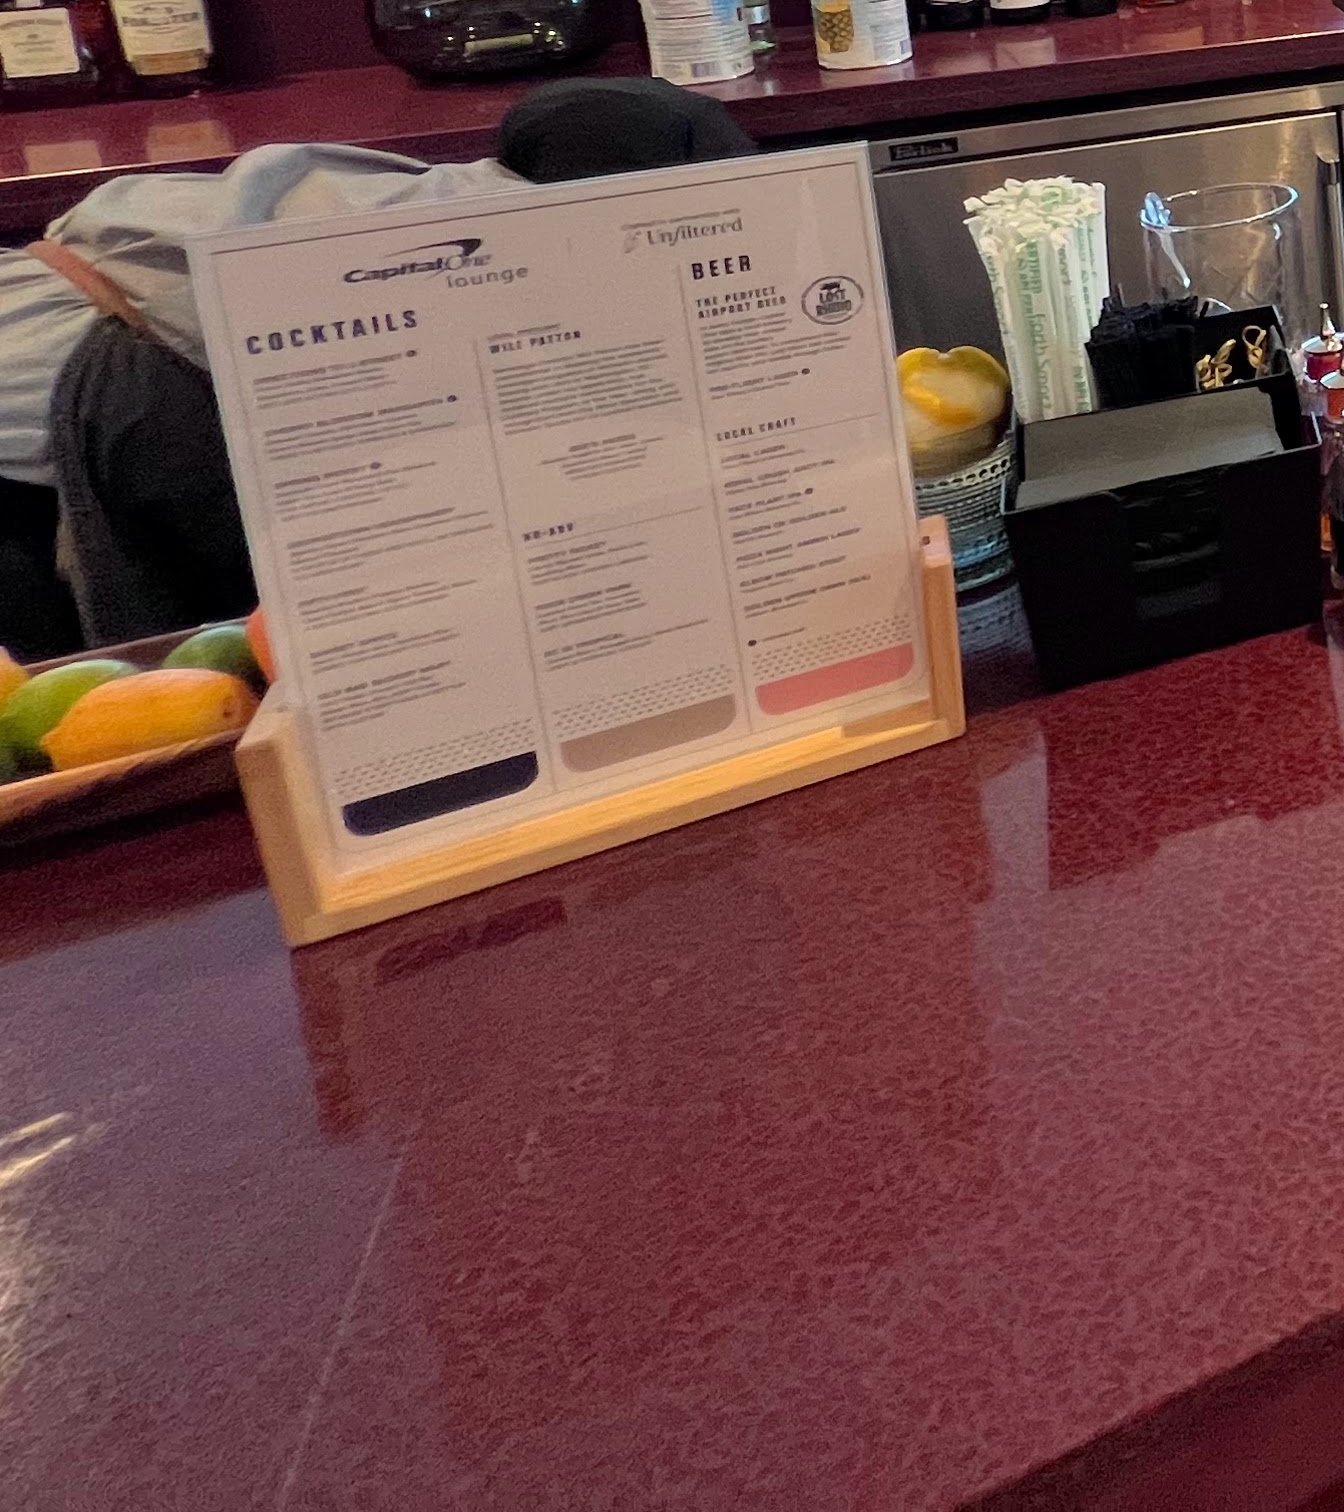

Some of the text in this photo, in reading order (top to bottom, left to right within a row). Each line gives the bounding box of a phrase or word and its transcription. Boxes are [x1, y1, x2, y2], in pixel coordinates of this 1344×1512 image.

[647, 216, 744, 247] Unfiltered
[446, 265, 529, 288] lounge
[690, 254, 752, 280] BEER
[245, 309, 418, 355] COCKTAILS
[716, 417, 796, 442] LOCAL CRAFT
